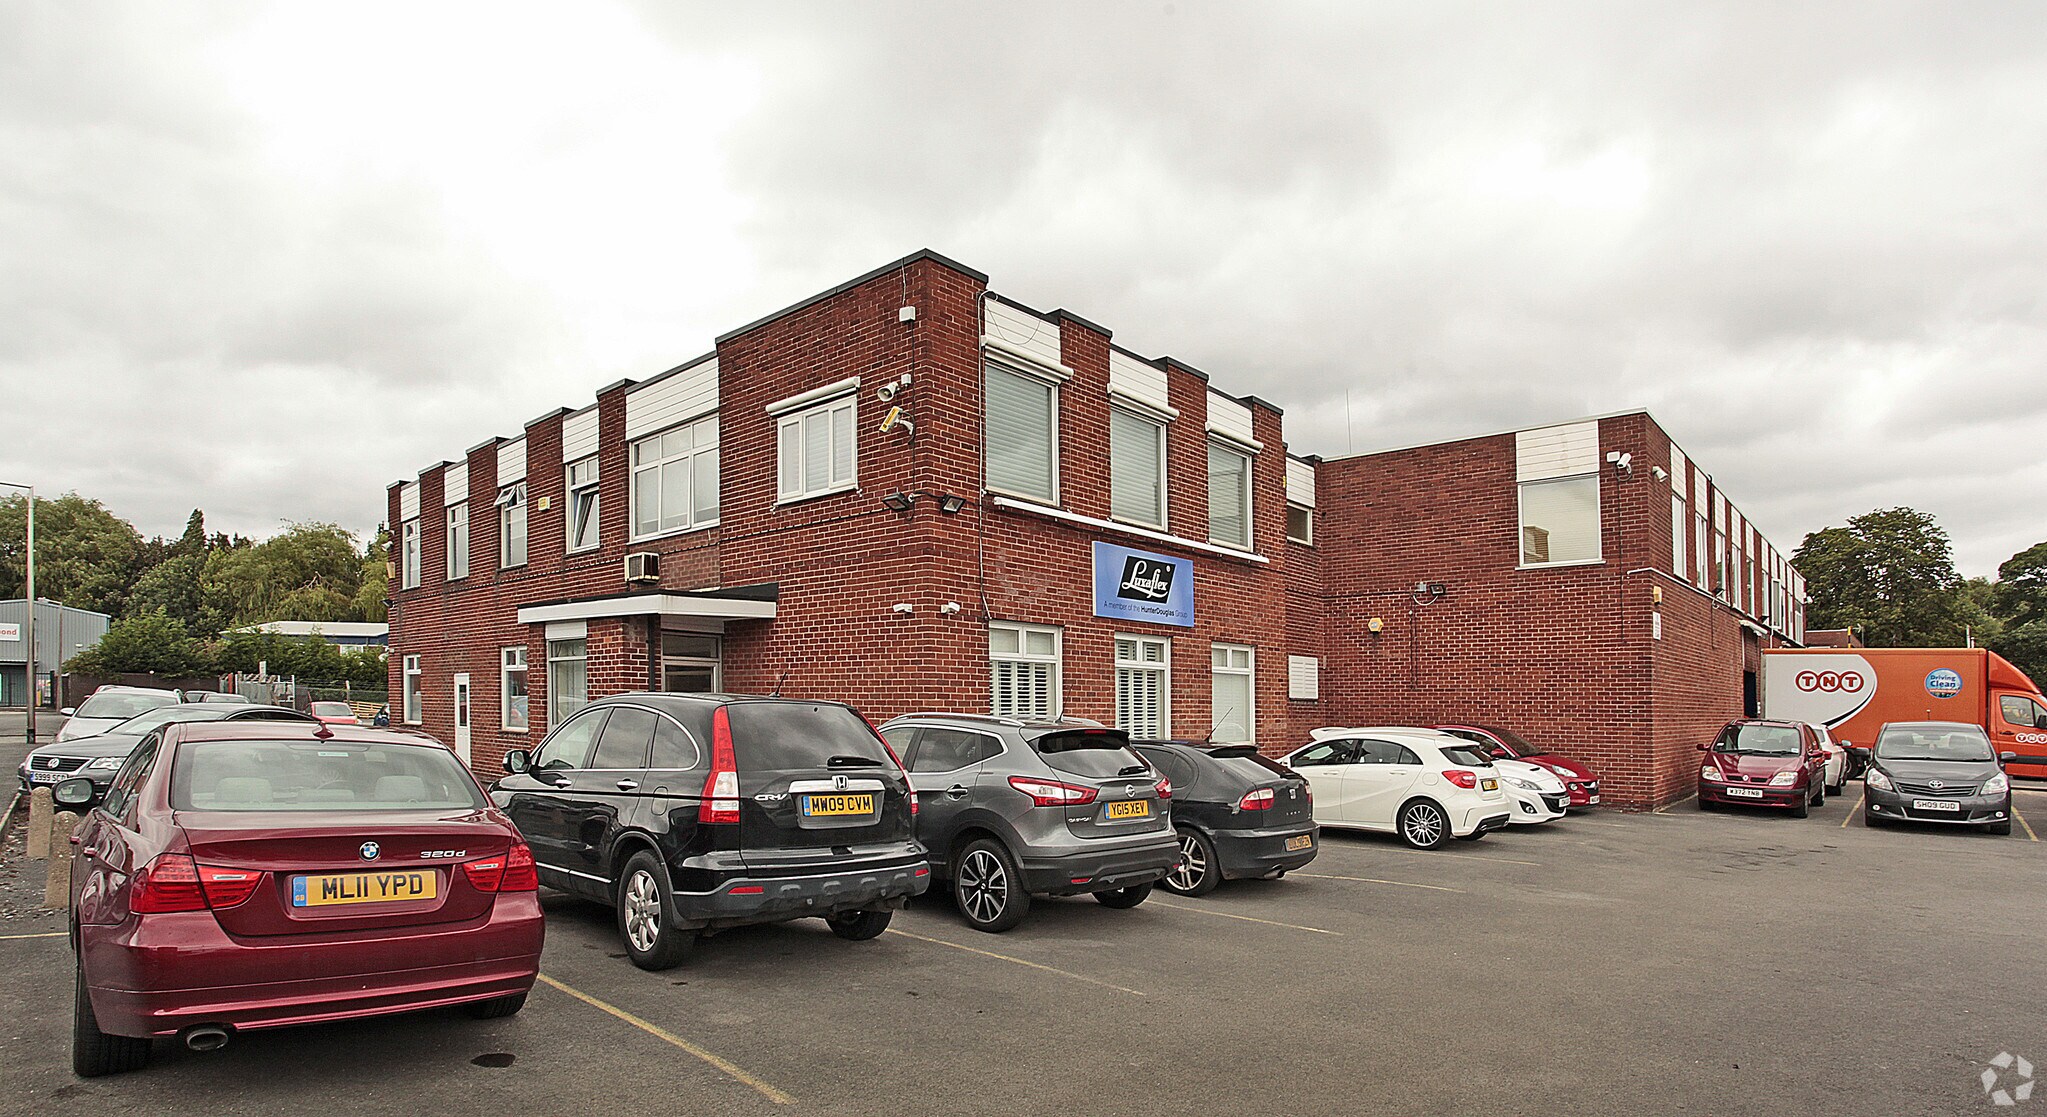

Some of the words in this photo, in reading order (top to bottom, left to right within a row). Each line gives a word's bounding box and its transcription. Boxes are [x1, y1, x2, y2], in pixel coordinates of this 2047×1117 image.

[1121, 560, 1168, 599] Luxaflex
[1800, 674, 1860, 689] TNT
[1930, 680, 1956, 688] Clean
[2017, 734, 2047, 743] TNT
[811, 797, 844, 812] MW09
[847, 796, 871, 811] CVM
[1130, 802, 1145, 814] XEV
[420, 850, 467, 858] 320d
[322, 877, 369, 900] ML11
[376, 874, 423, 896] YPD
